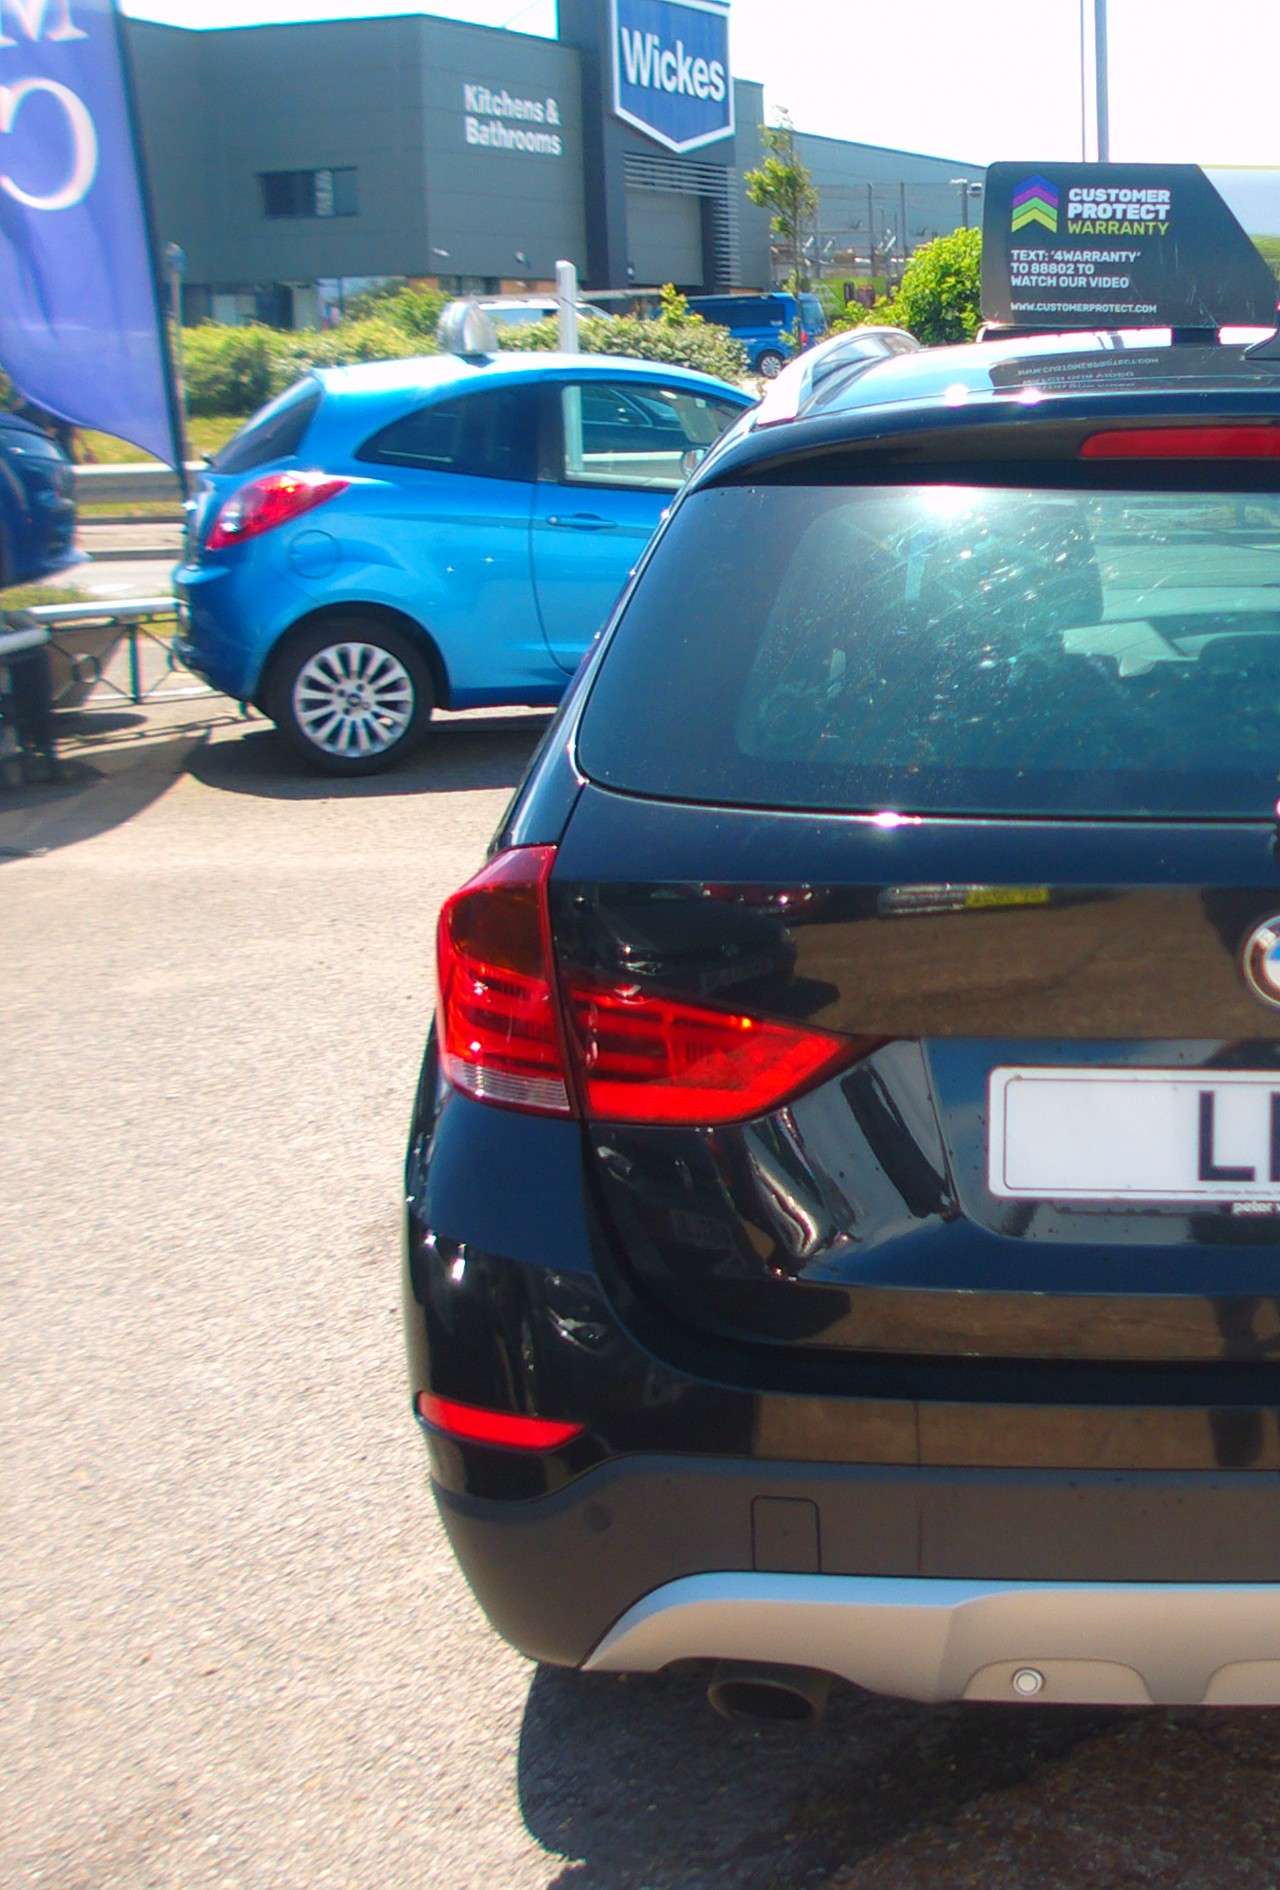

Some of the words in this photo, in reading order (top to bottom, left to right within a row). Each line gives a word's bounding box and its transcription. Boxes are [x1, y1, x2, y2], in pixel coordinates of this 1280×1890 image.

[621, 26, 726, 102] Wickes
[464, 84, 543, 122] Kitchens
[546, 98, 560, 125] &
[465, 117, 562, 155] Bathrooms
[1068, 188, 1171, 203] CUSTOMER
[1067, 203, 1171, 220] PROTECT
[1067, 220, 1169, 235] WARRANTY
[1010, 250, 1048, 261] TEXT:
[1010, 263, 1028, 274] TO
[1031, 263, 1074, 275] 88802
[1076, 263, 1094, 275] TO
[1010, 276, 1057, 287] WATCH
[1059, 276, 1087, 288] OUR
[1089, 277, 1129, 289] VIDEO
[1010, 301, 1157, 313] WWW.CUSTOMERPROTECT.COM
